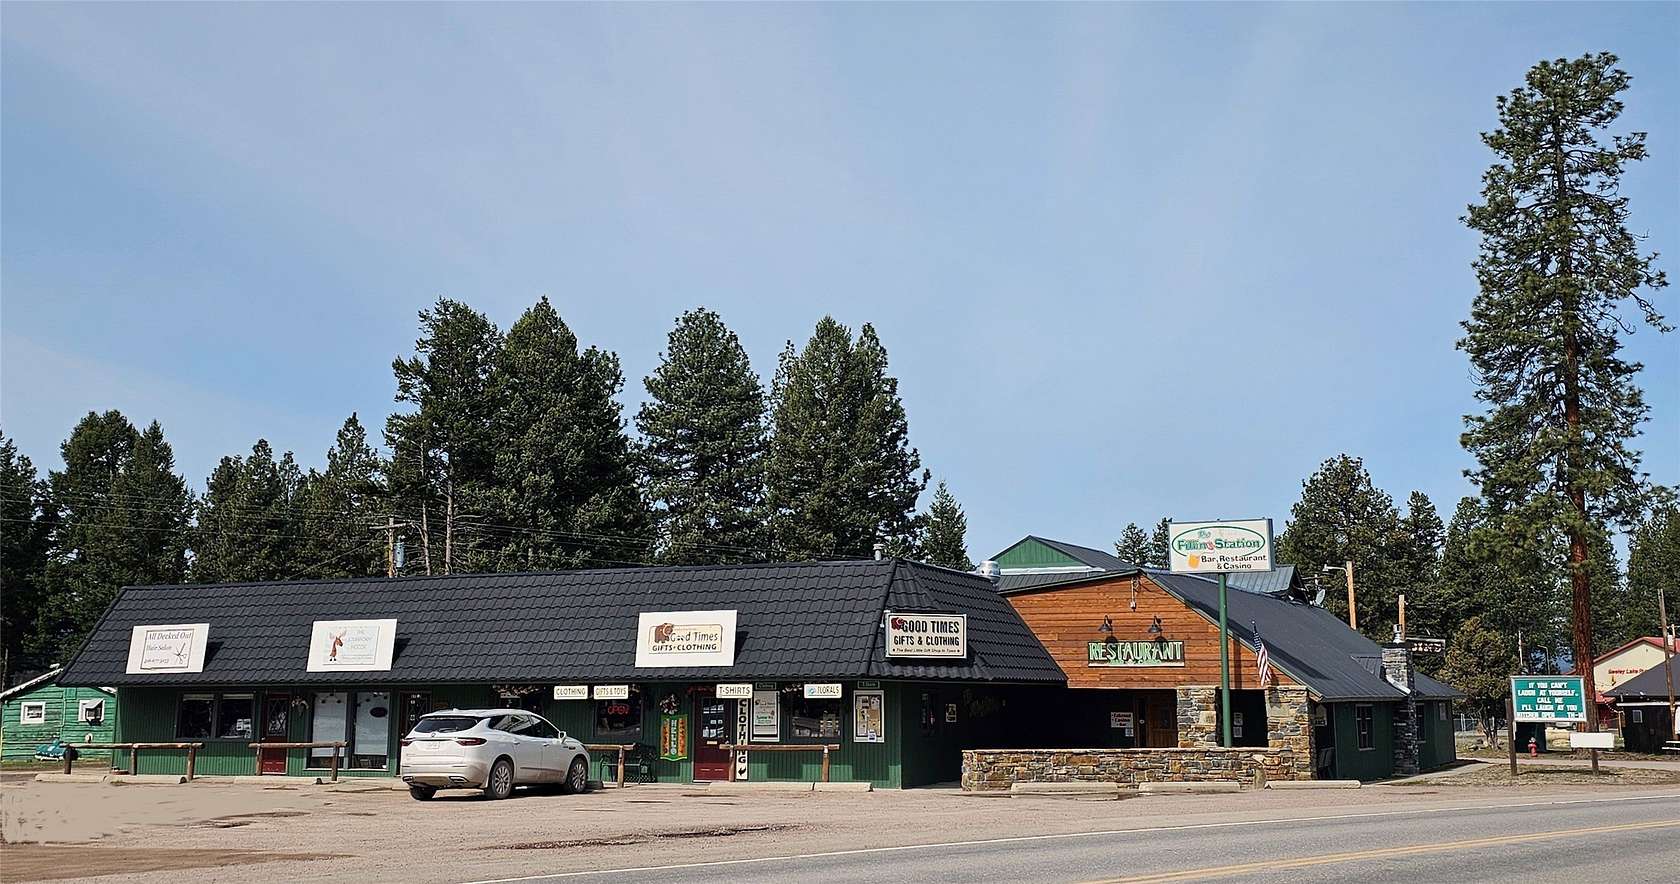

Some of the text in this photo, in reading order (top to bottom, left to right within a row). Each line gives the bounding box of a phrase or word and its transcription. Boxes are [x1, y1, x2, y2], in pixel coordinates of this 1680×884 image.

[1215, 538, 1260, 549] Station
[1201, 554, 1268, 563] Bar, Restaurant
[902, 620, 960, 633] GOOD TIMES
[148, 632, 157, 640] All
[157, 631, 180, 640] Decked
[670, 631, 719, 642] Good Times
[894, 635, 960, 646] GIFTS & CLOTHING
[1088, 641, 1183, 660] RESTAURANT
[614, 687, 627, 695] TOYS
[719, 686, 751, 695] T-SHIRTS
[738, 699, 747, 764] CLOTHING
